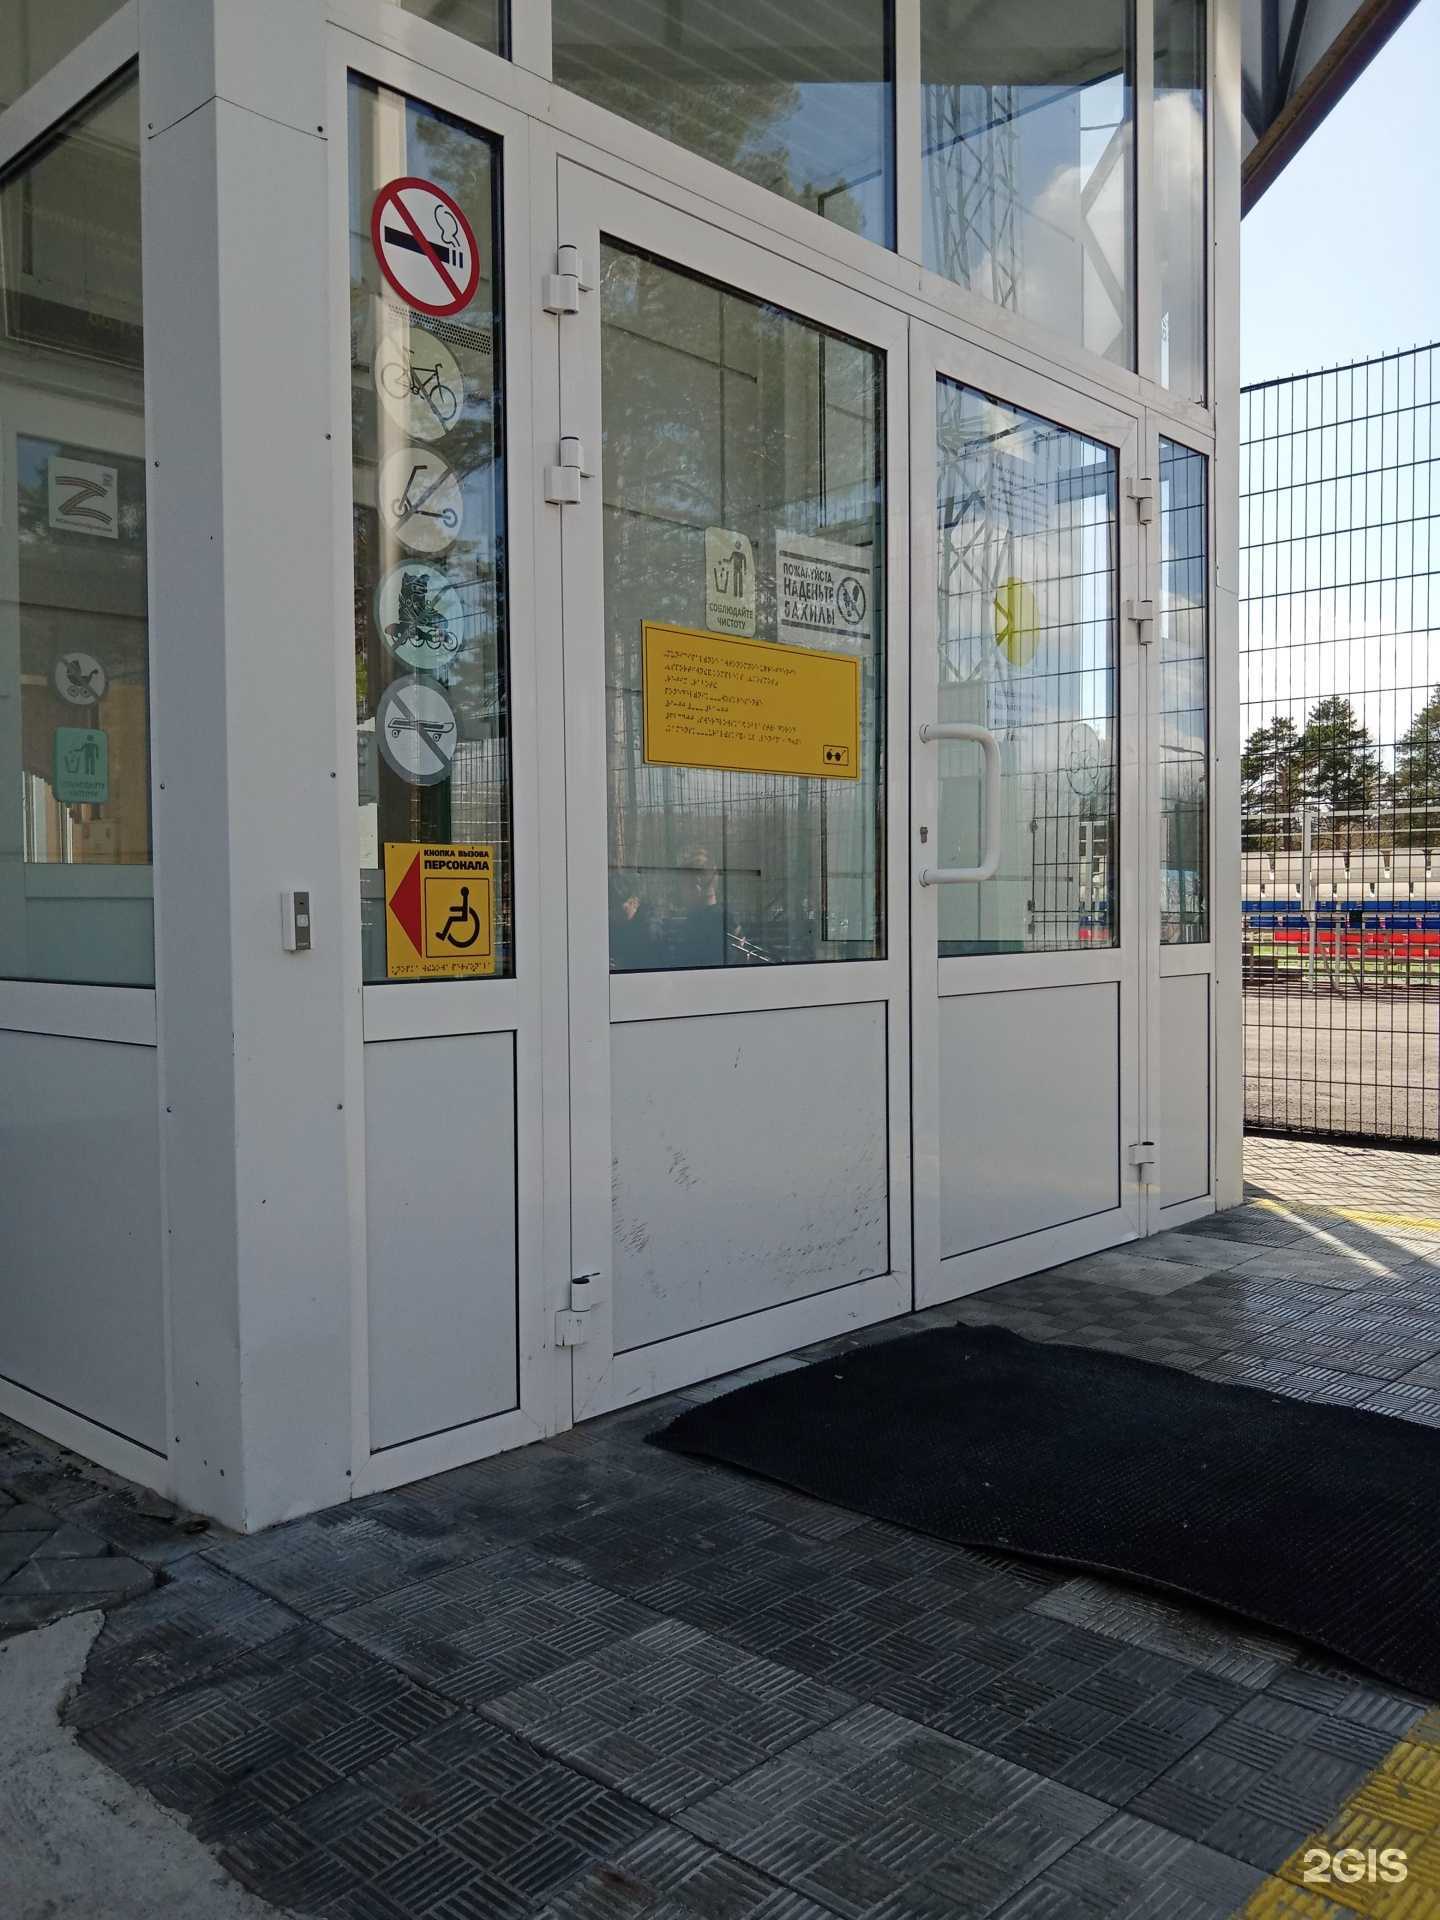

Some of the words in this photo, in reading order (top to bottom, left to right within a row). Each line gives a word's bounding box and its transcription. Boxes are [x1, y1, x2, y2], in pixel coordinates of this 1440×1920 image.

[783, 577, 834, 603] НАДЕНЬТЕ
[709, 602, 753, 620] СОБЛЮДАЙТЕ
[784, 600, 835, 625] БАХИЛЫ
[717, 617, 746, 630] ЧИСТОТУ
[423, 849, 455, 857] КНОПКА
[457, 850, 489, 858] ВЫЗОВА
[424, 860, 489, 870] ПЕРСОНАЛА
